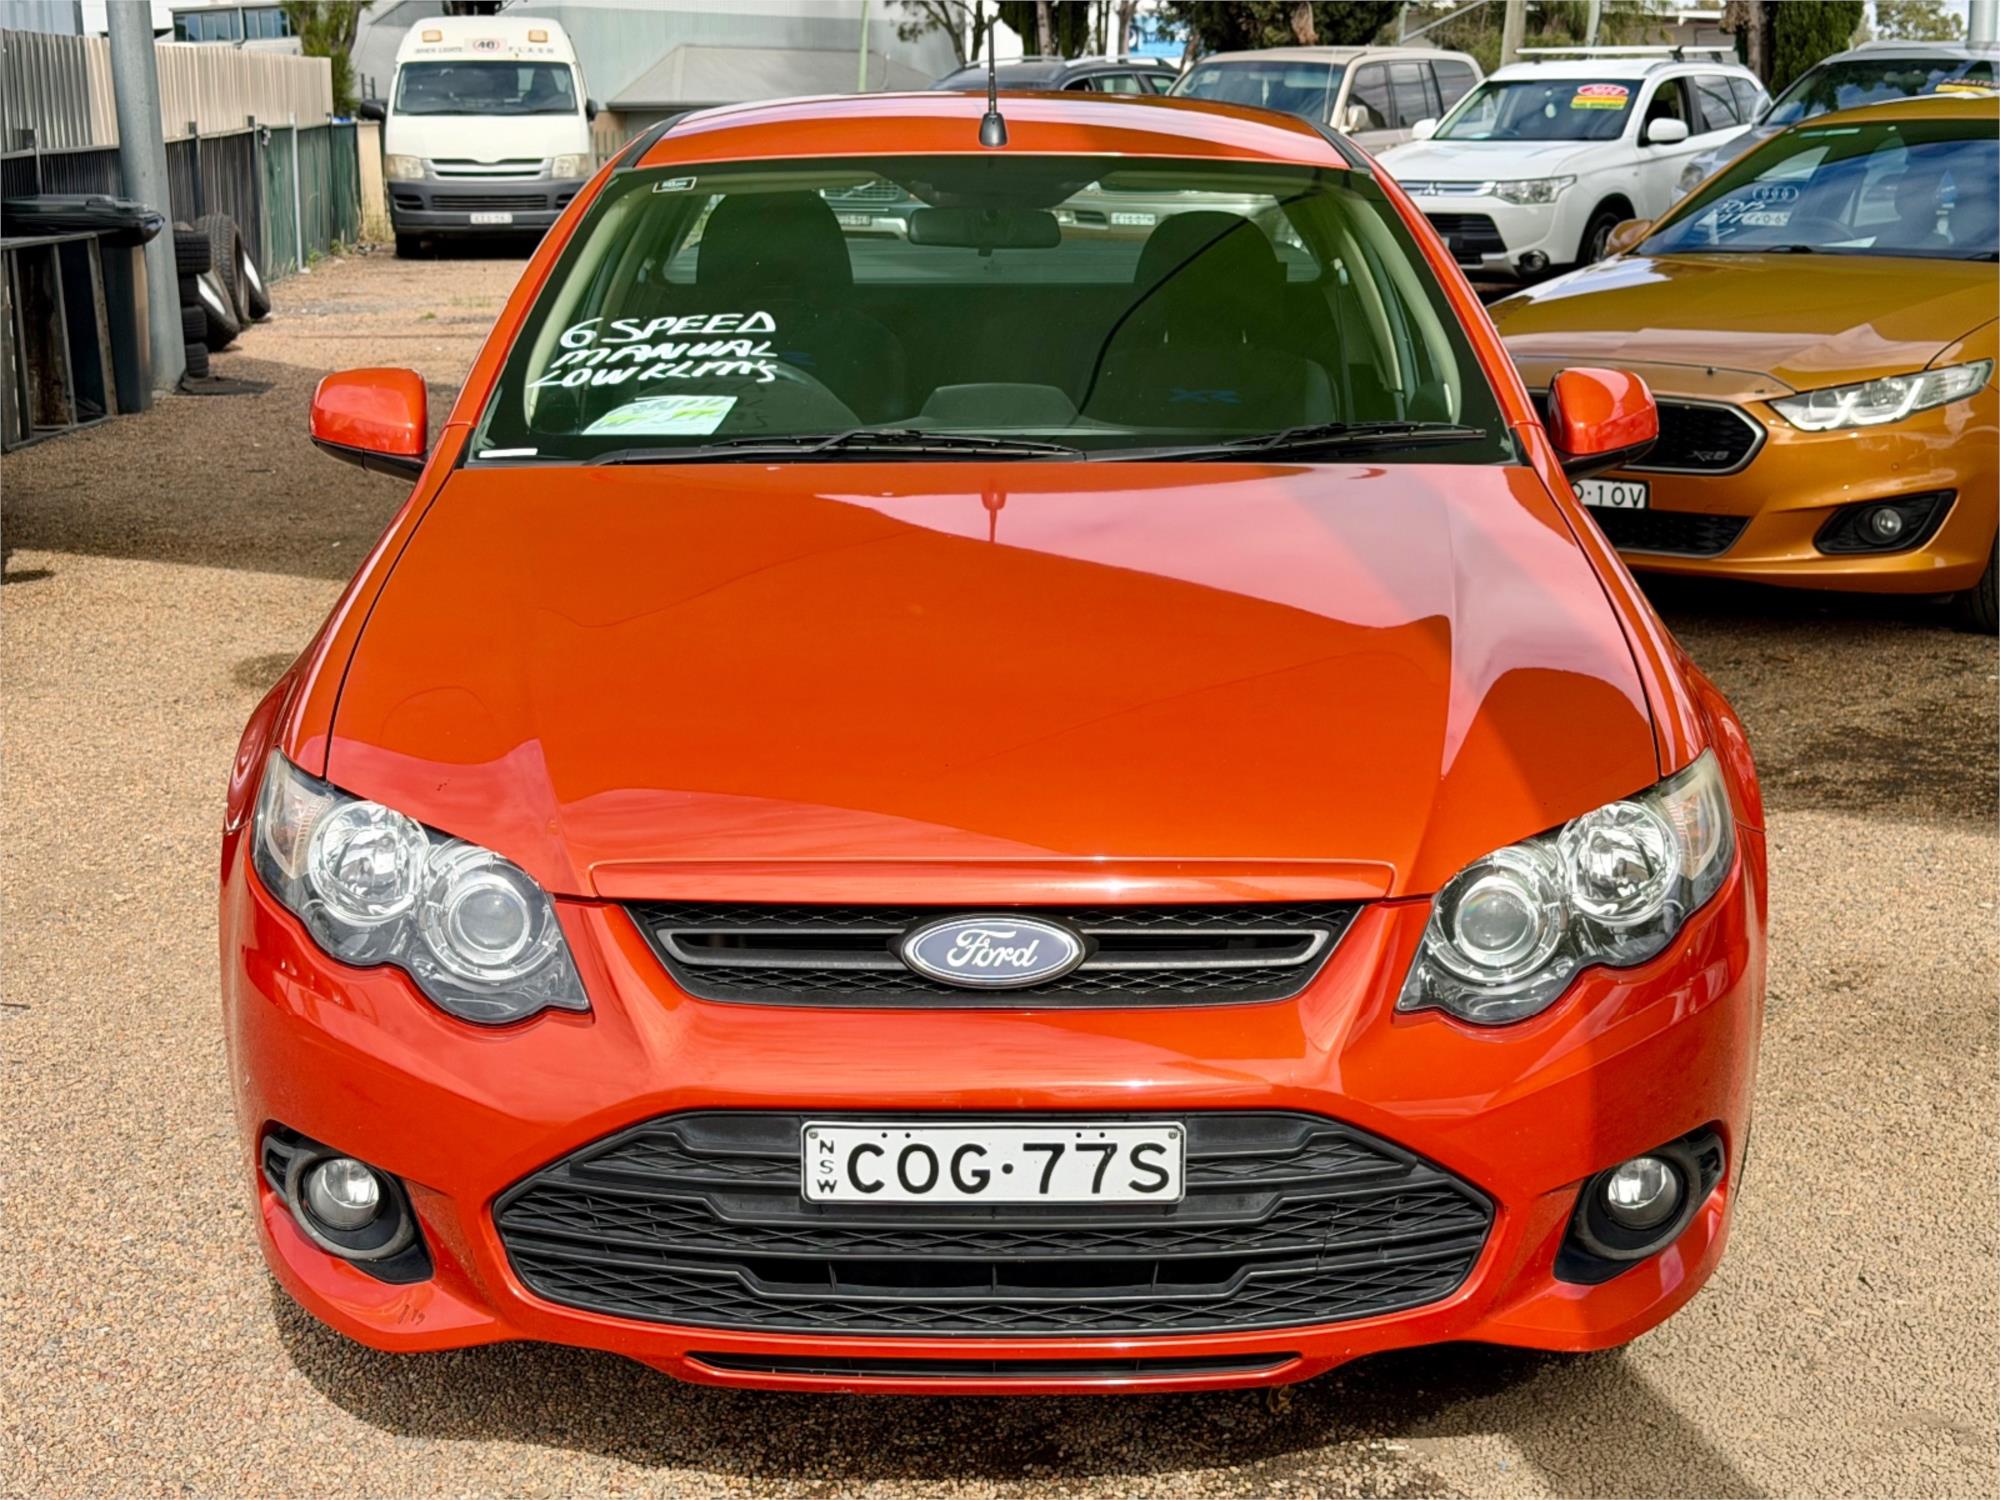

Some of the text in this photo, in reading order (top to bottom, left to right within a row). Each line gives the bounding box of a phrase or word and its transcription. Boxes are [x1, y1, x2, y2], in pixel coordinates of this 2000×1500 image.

[560, 310, 777, 349] 6 SPEED
[550, 338, 779, 369] MANUAL
[526, 363, 641, 388] LOW
[946, 928, 1041, 968] Ford
[817, 1139, 838, 1194] NSW
